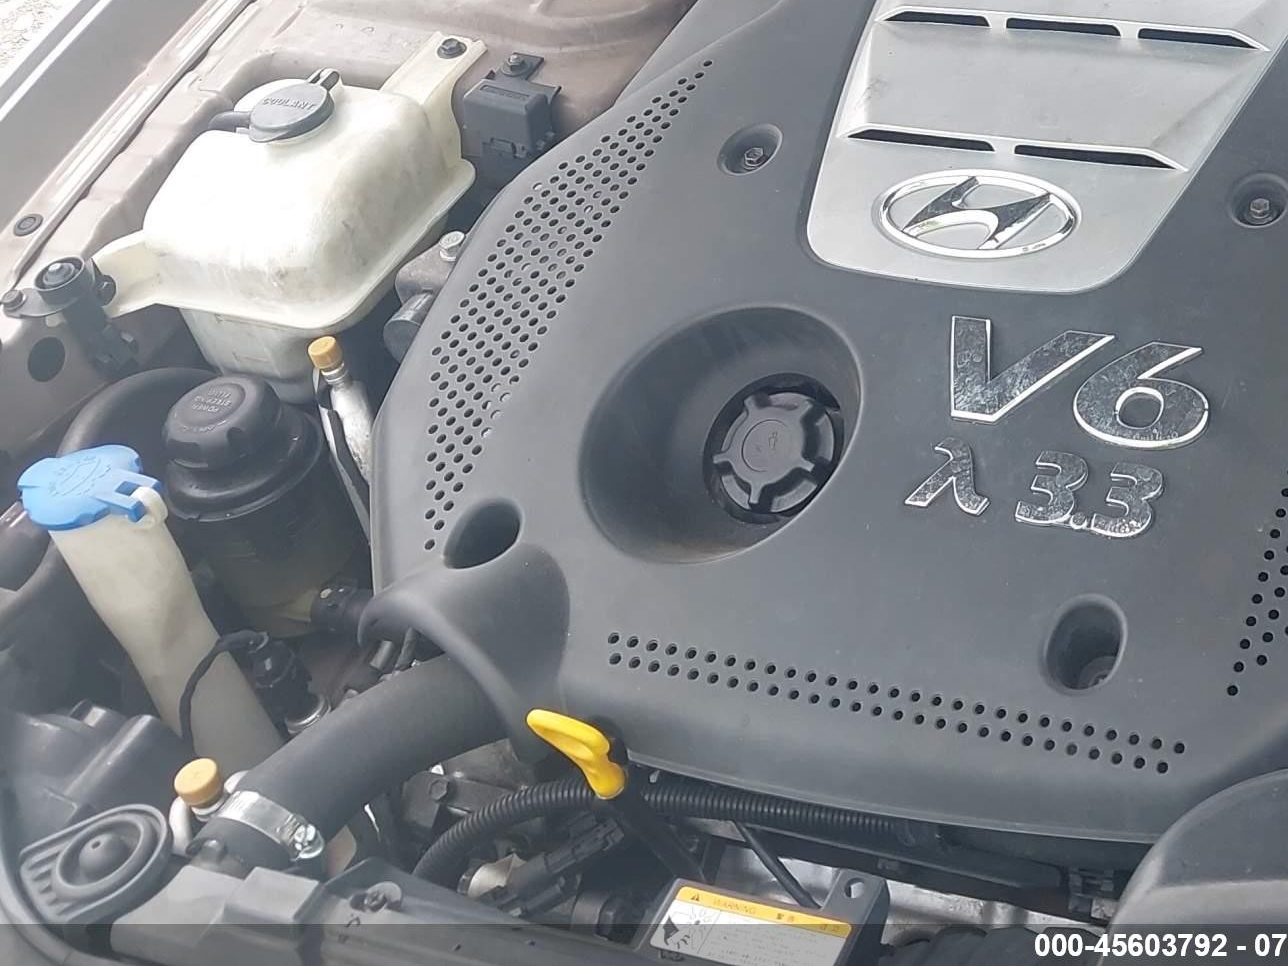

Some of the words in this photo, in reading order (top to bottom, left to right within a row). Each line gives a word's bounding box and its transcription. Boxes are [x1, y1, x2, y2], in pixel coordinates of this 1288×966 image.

[262, 97, 317, 111] COOLANT
[949, 315, 1209, 449] V6
[1014, 449, 1166, 538] 3.3
[713, 898, 756, 915] WARNING
